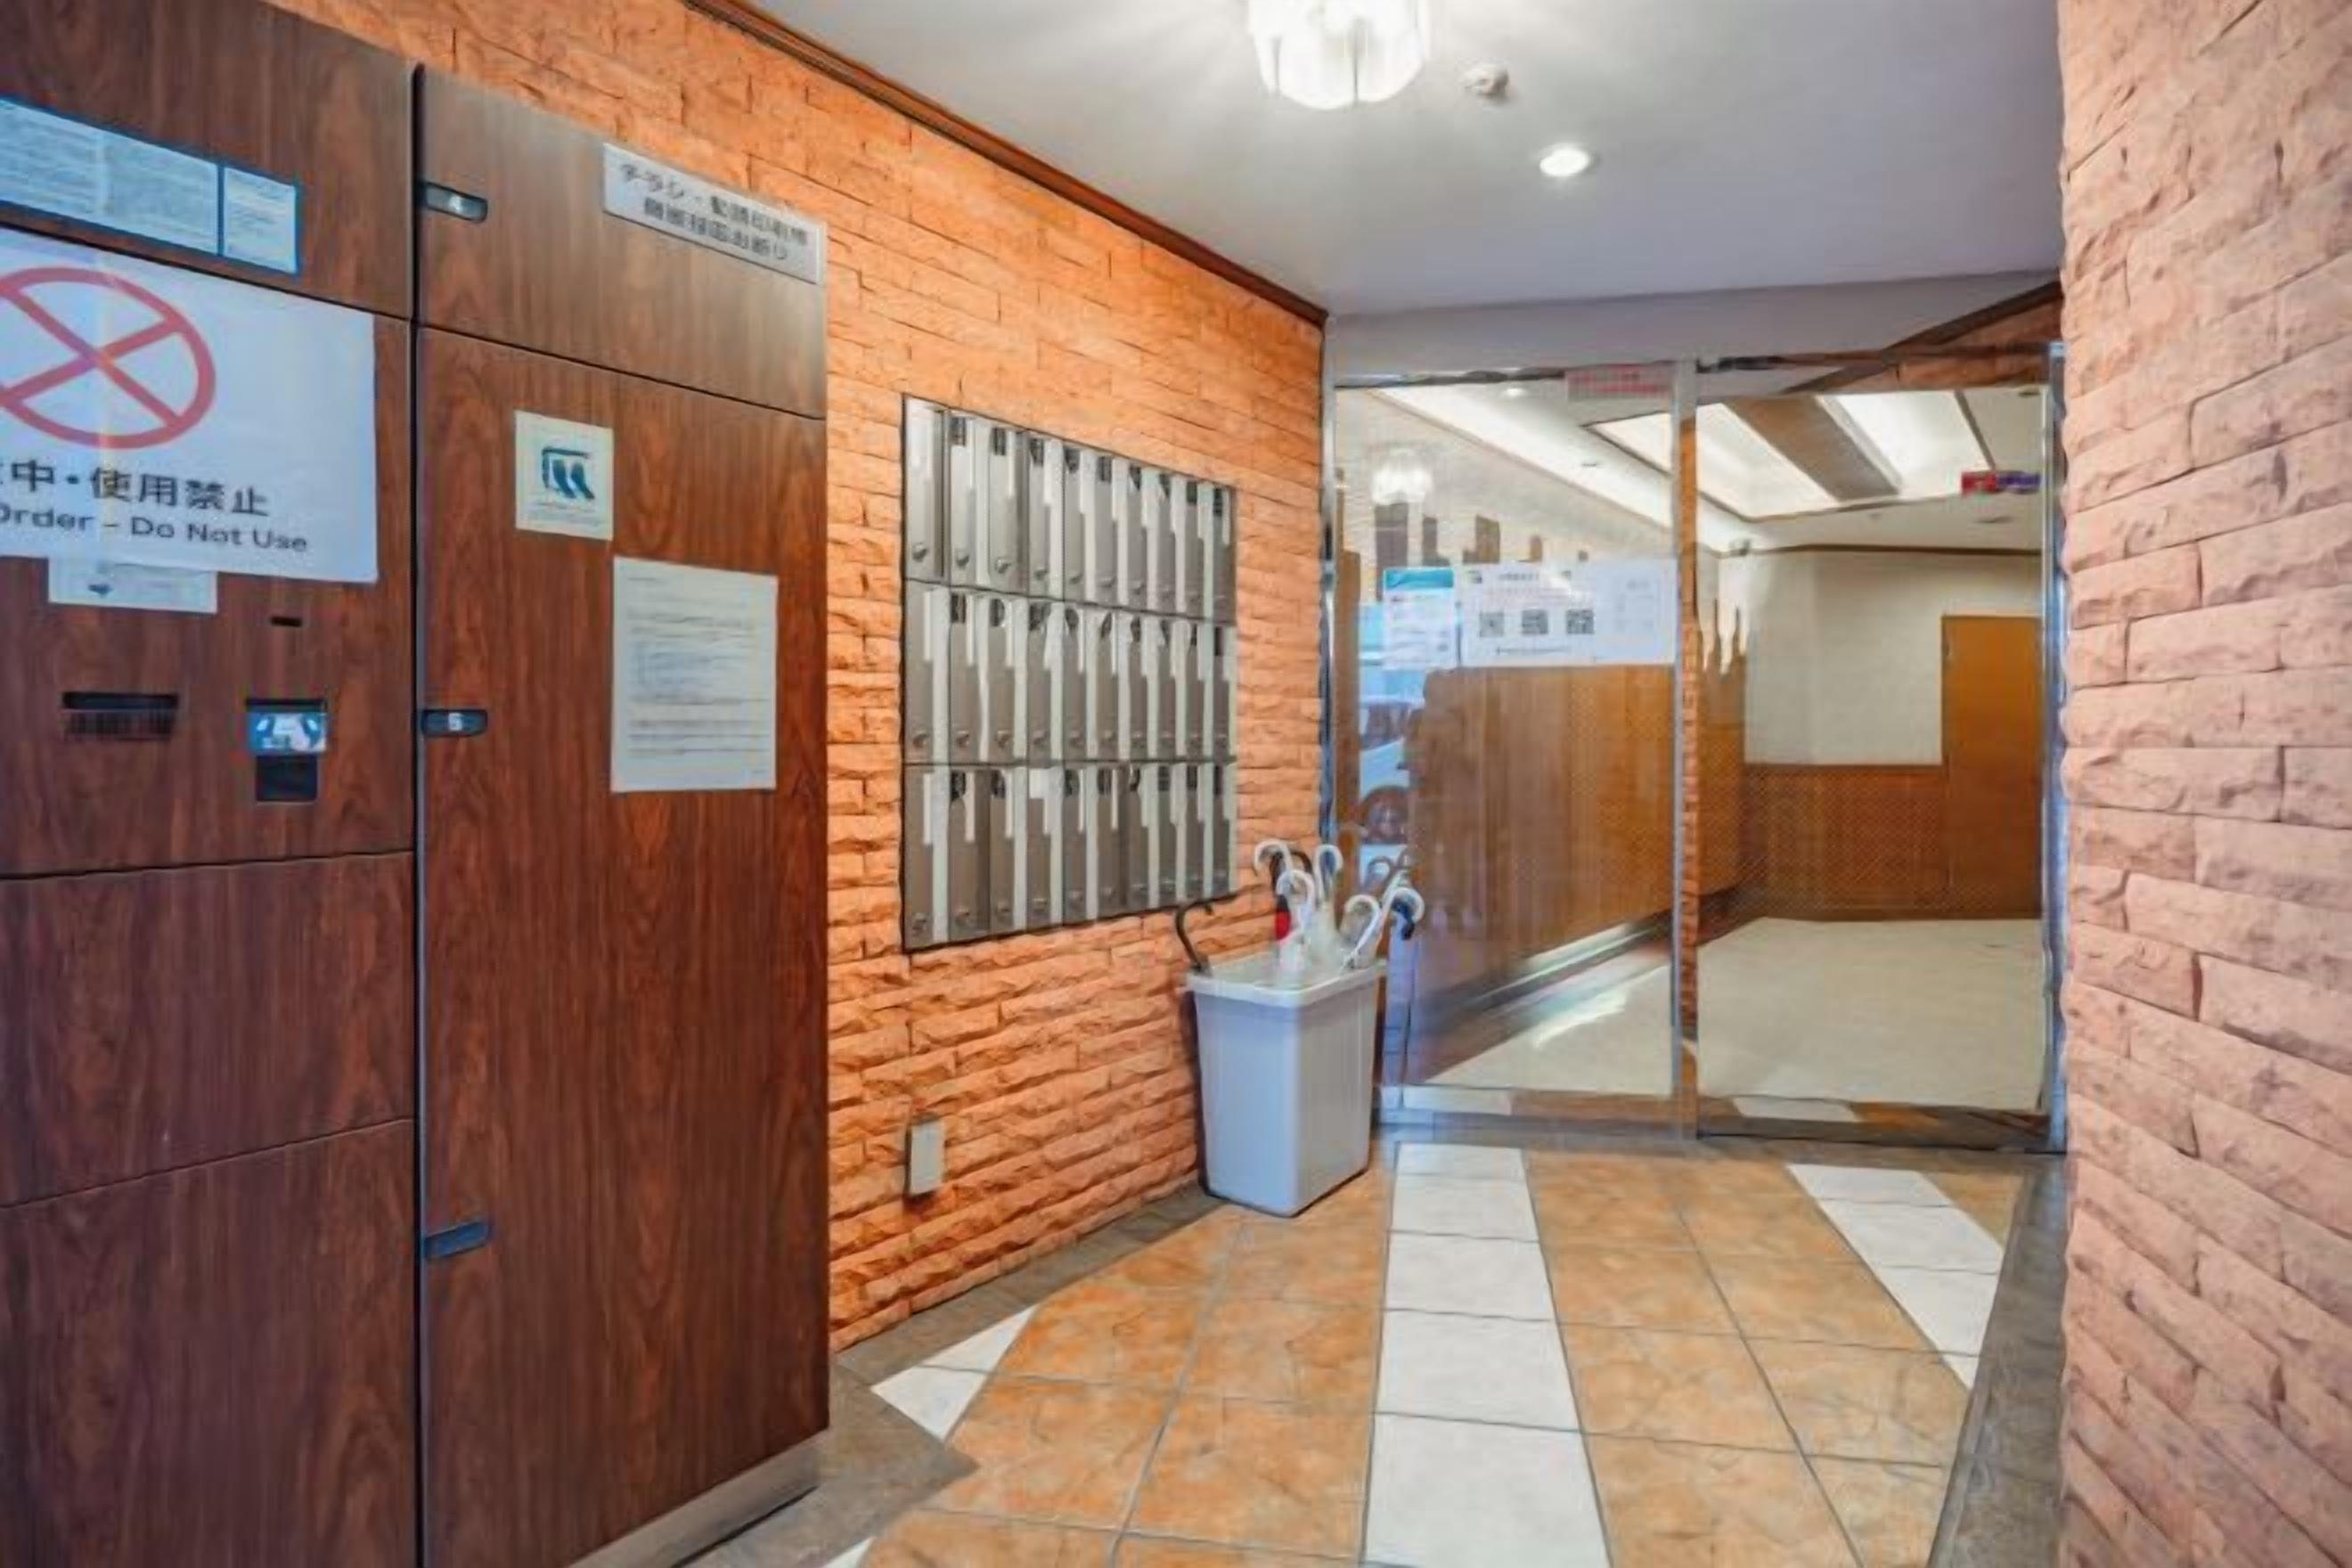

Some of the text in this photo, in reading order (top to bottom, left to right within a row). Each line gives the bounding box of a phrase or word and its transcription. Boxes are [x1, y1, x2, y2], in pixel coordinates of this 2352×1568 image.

[0, 460, 269, 516] 中・使用禁止
[132, 516, 175, 539] Do
[188, 524, 243, 546] Not
[253, 528, 307, 552] Use
